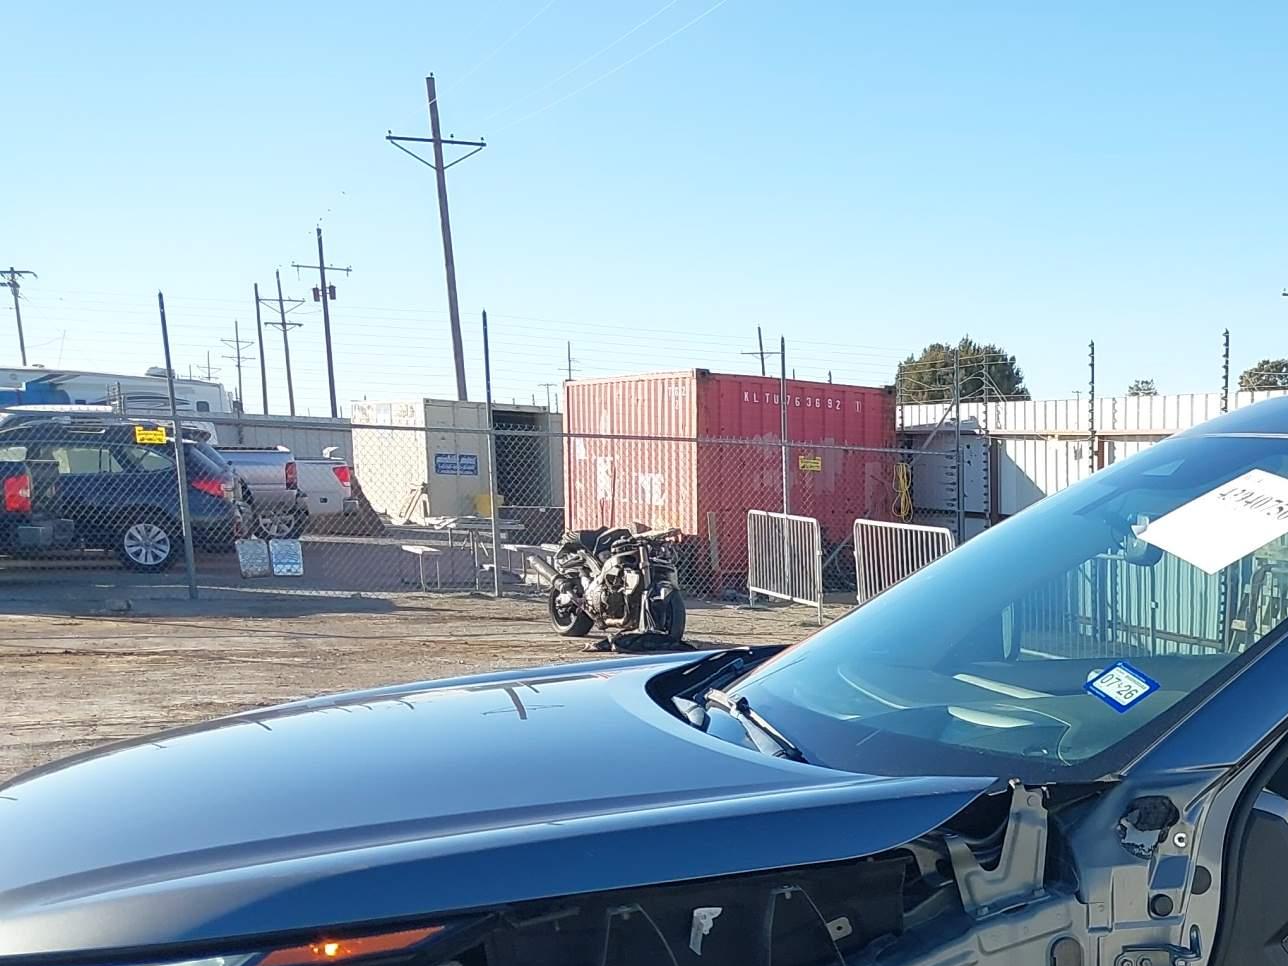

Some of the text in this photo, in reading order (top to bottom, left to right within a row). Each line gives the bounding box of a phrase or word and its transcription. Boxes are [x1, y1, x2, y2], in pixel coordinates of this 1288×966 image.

[786, 395, 841, 410] 763692
[1100, 673, 1122, 688] 07
[1116, 684, 1139, 700] 26
